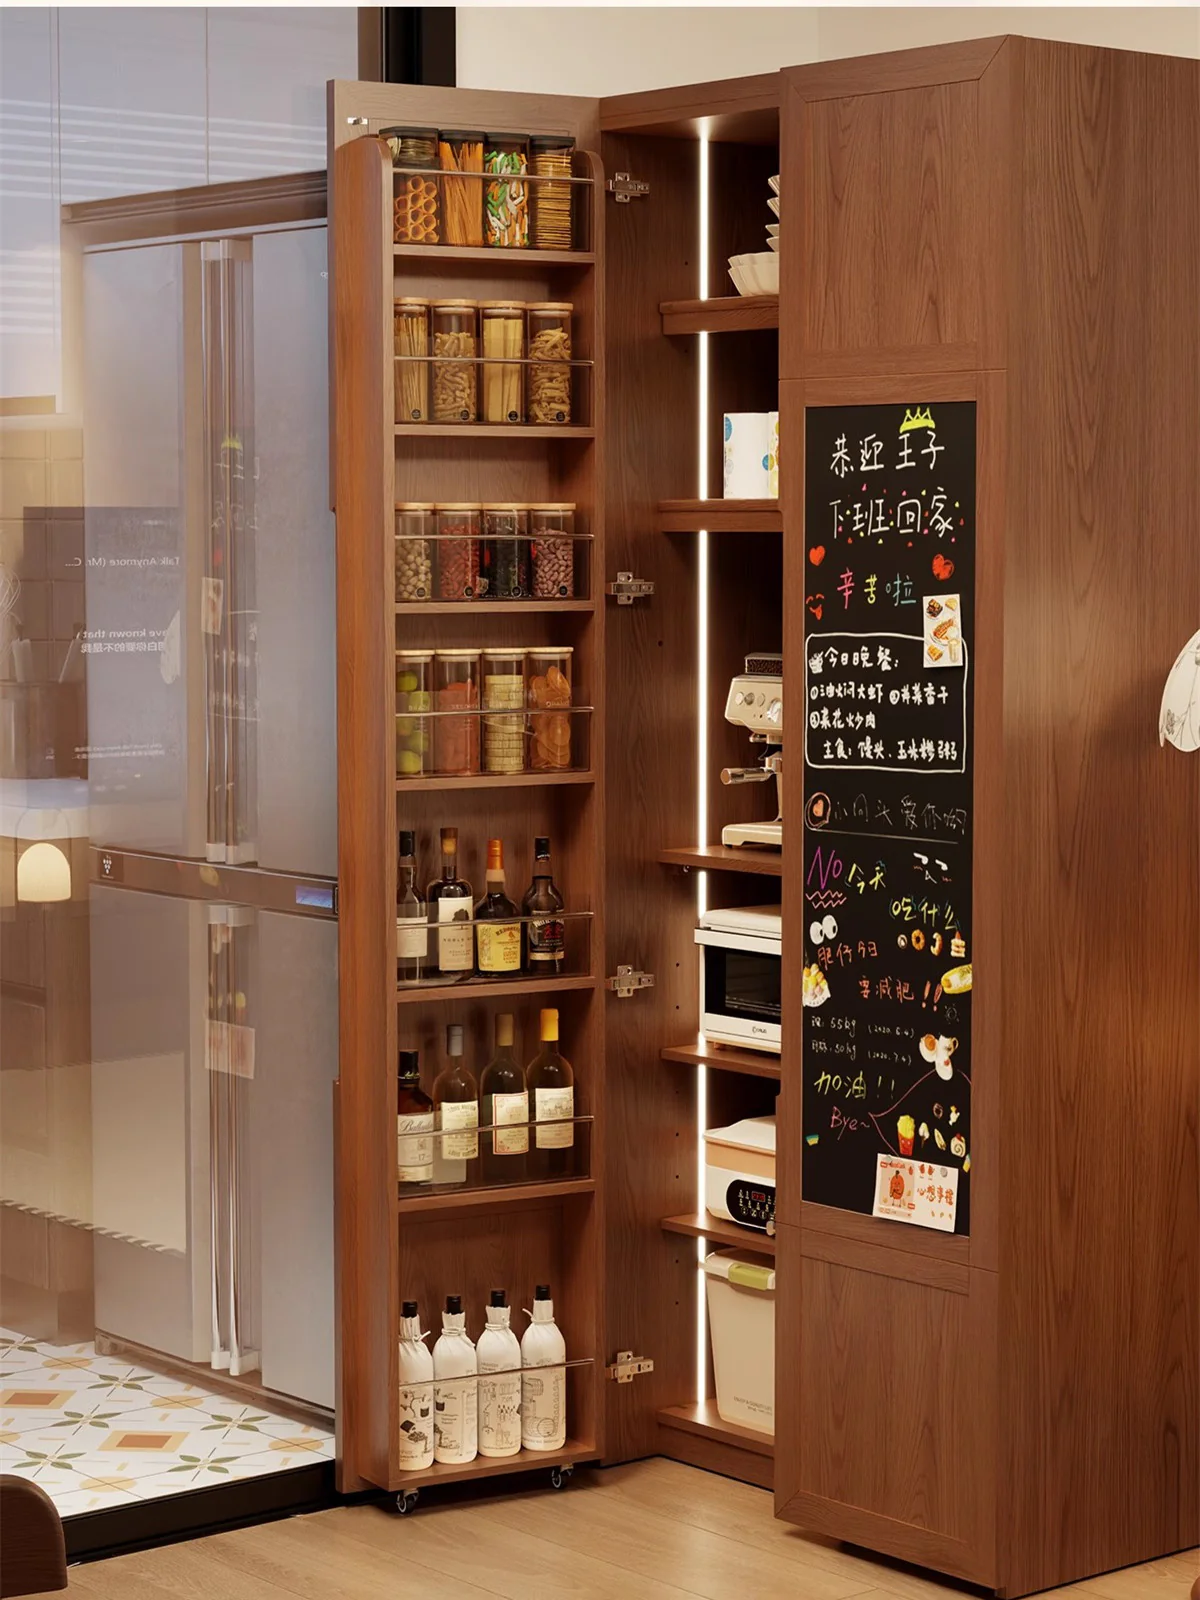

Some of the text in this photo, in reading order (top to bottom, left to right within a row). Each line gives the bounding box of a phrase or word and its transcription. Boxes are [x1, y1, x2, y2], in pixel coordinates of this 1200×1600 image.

[829, 487, 953, 539] 下班回家
[837, 567, 916, 609] 辛苦啦
[806, 846, 843, 889] No
[891, 896, 958, 931] 吃什么
